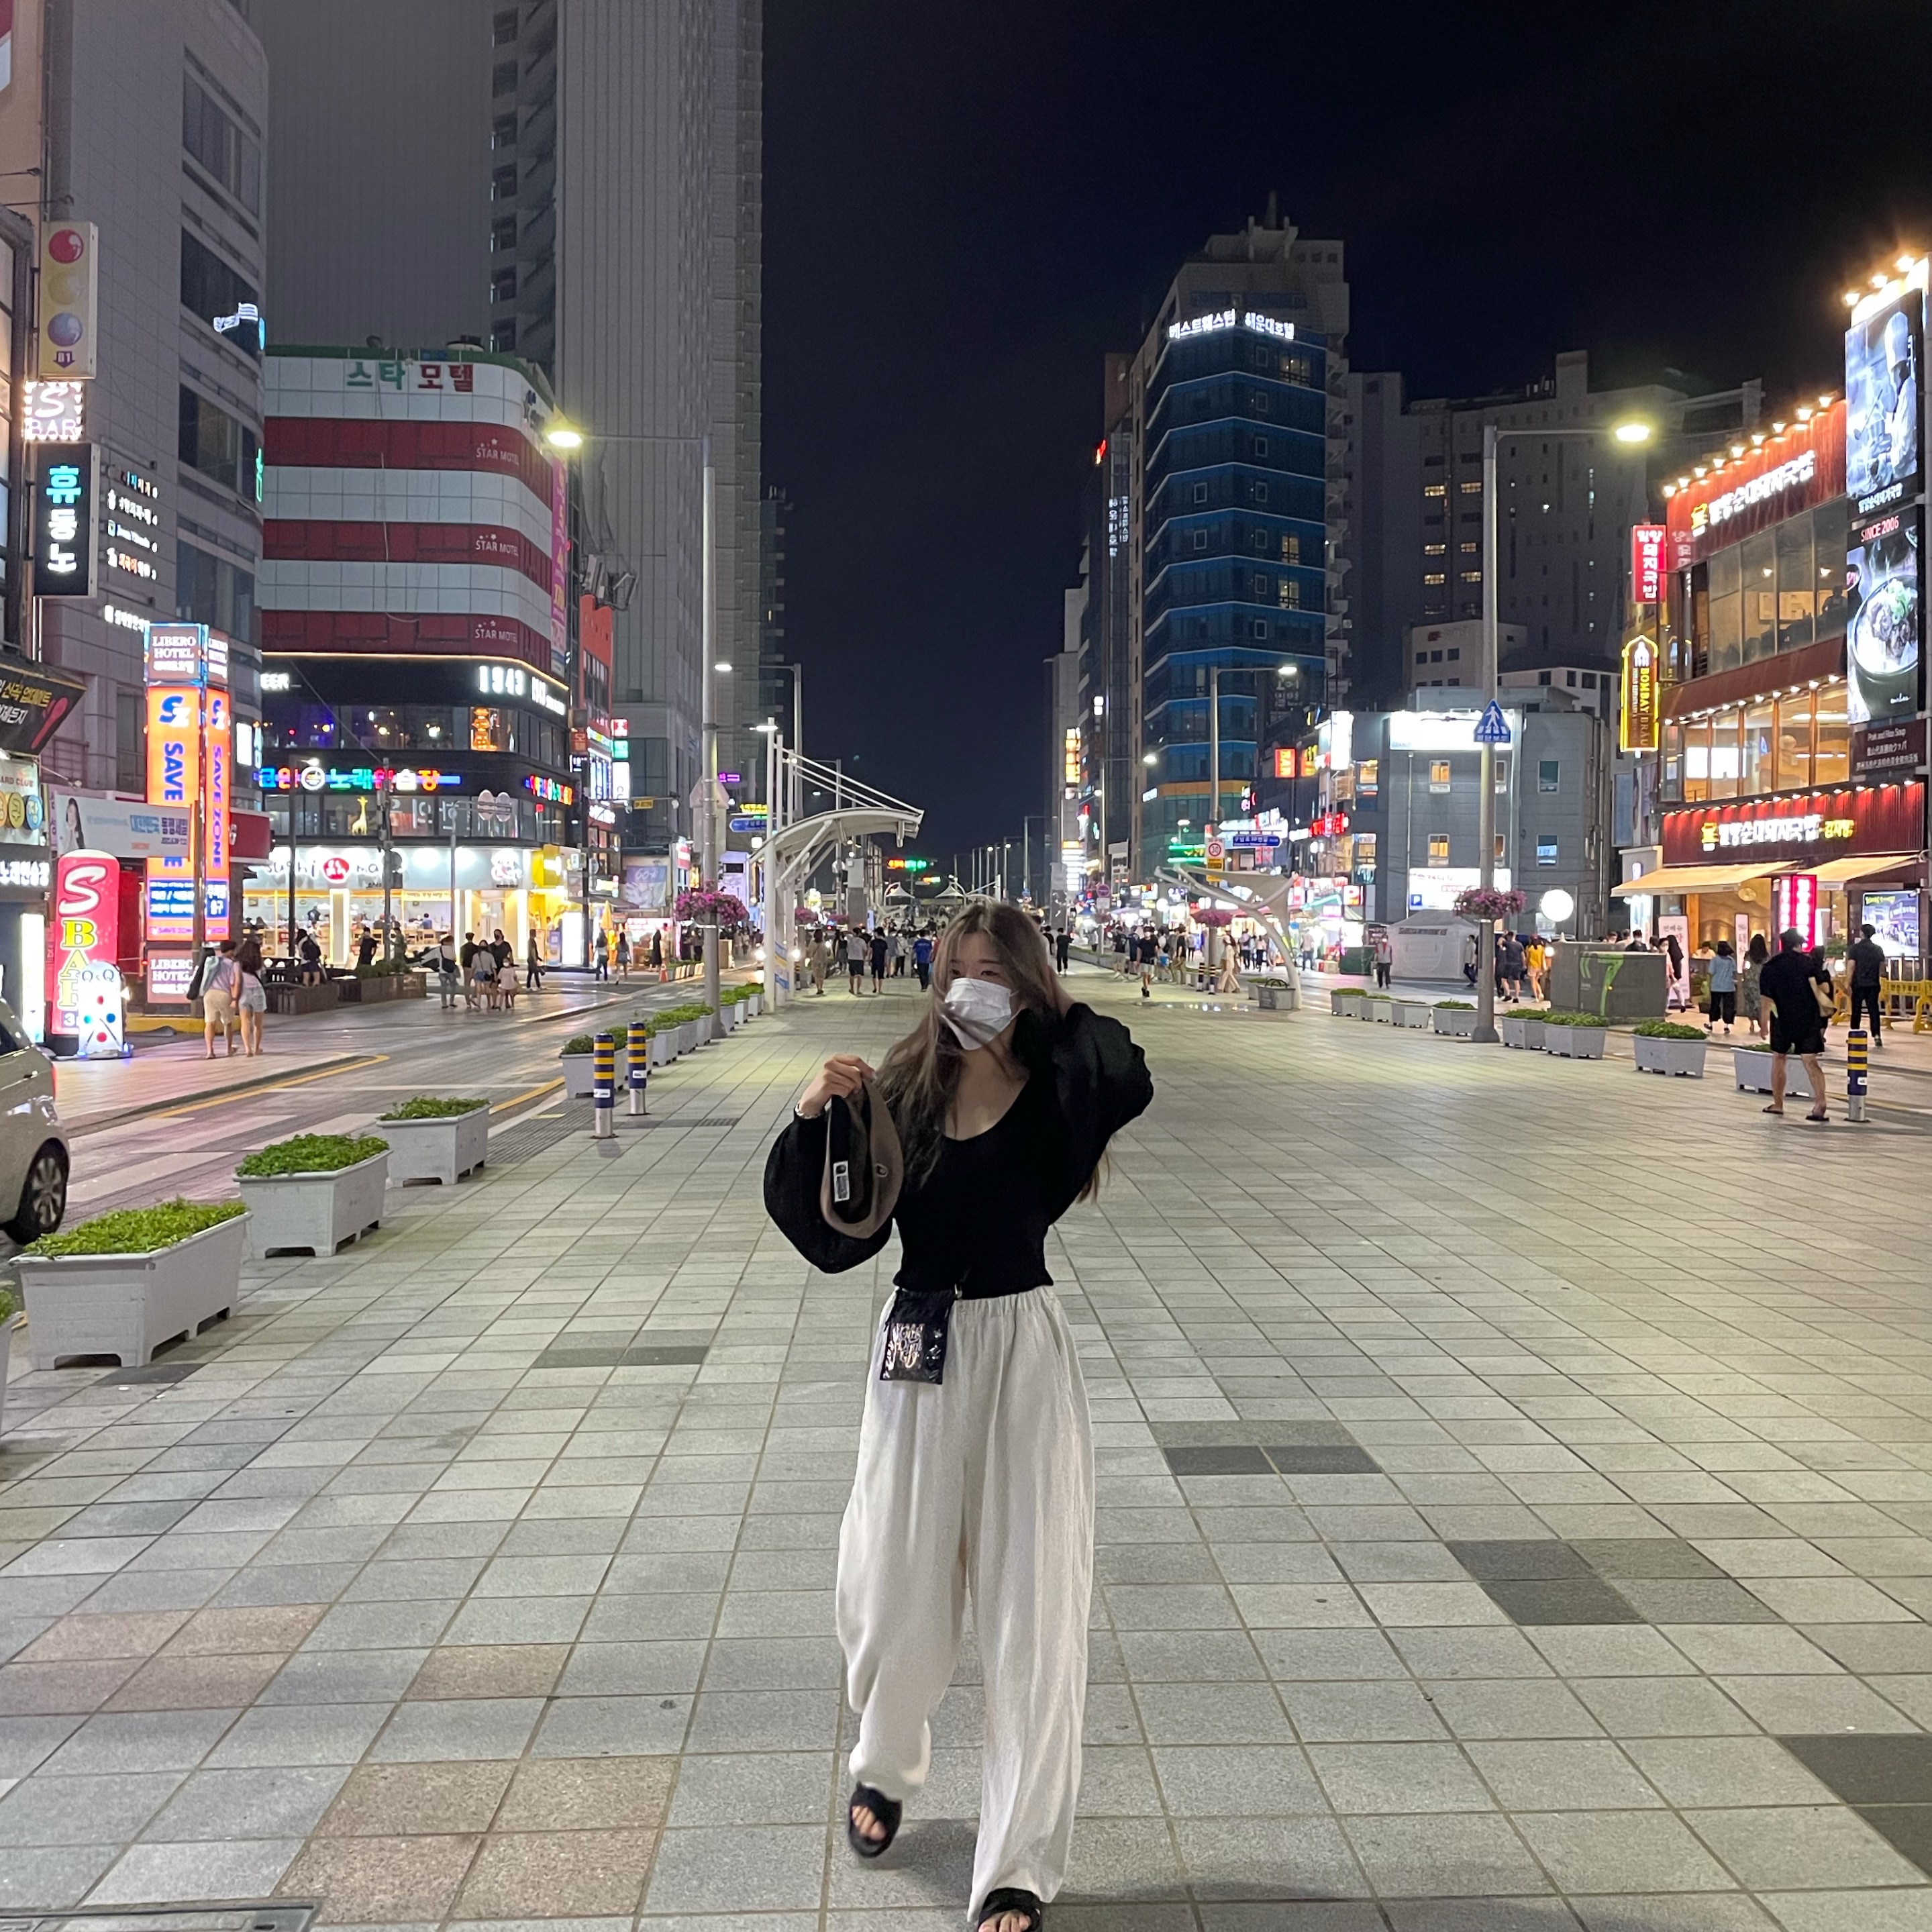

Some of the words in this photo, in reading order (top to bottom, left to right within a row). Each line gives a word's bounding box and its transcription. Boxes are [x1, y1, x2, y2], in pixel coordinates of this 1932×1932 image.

[1169, 309, 1235, 339] 베스트웨스턴
[1245, 312, 1294, 340] 해운대호텔
[58, 352, 70, 363] B1
[347, 362, 405, 391] 스타
[418, 364, 474, 393] 모텔
[30, 419, 77, 436] BAR
[476, 448, 498, 459] STAR
[500, 450, 519, 466] MOTEL
[1637, 529, 1663, 543] 밀양
[1861, 523, 1881, 543] SINCE
[1882, 515, 1899, 535] 2006
[475, 540, 497, 552] STAR
[499, 542, 519, 557] MOTEL
[1642, 544, 1658, 599] 돼지국밥
[152, 635, 197, 647] LIBERO
[474, 628, 497, 639] STAR
[498, 631, 518, 643] MOTEL
[154, 648, 195, 659] HOTEL
[479, 665, 524, 695] 1943
[1, 682, 23, 701] 신곡
[1639, 667, 1650, 713] BOMBAY
[164, 742, 183, 801] SAVE
[212, 745, 222, 803] SAVE
[16, 778, 34, 788] CLUB
[212, 808, 223, 869] ZONE
[1211, 846, 1219, 854] 30
[58, 866, 107, 915] S
